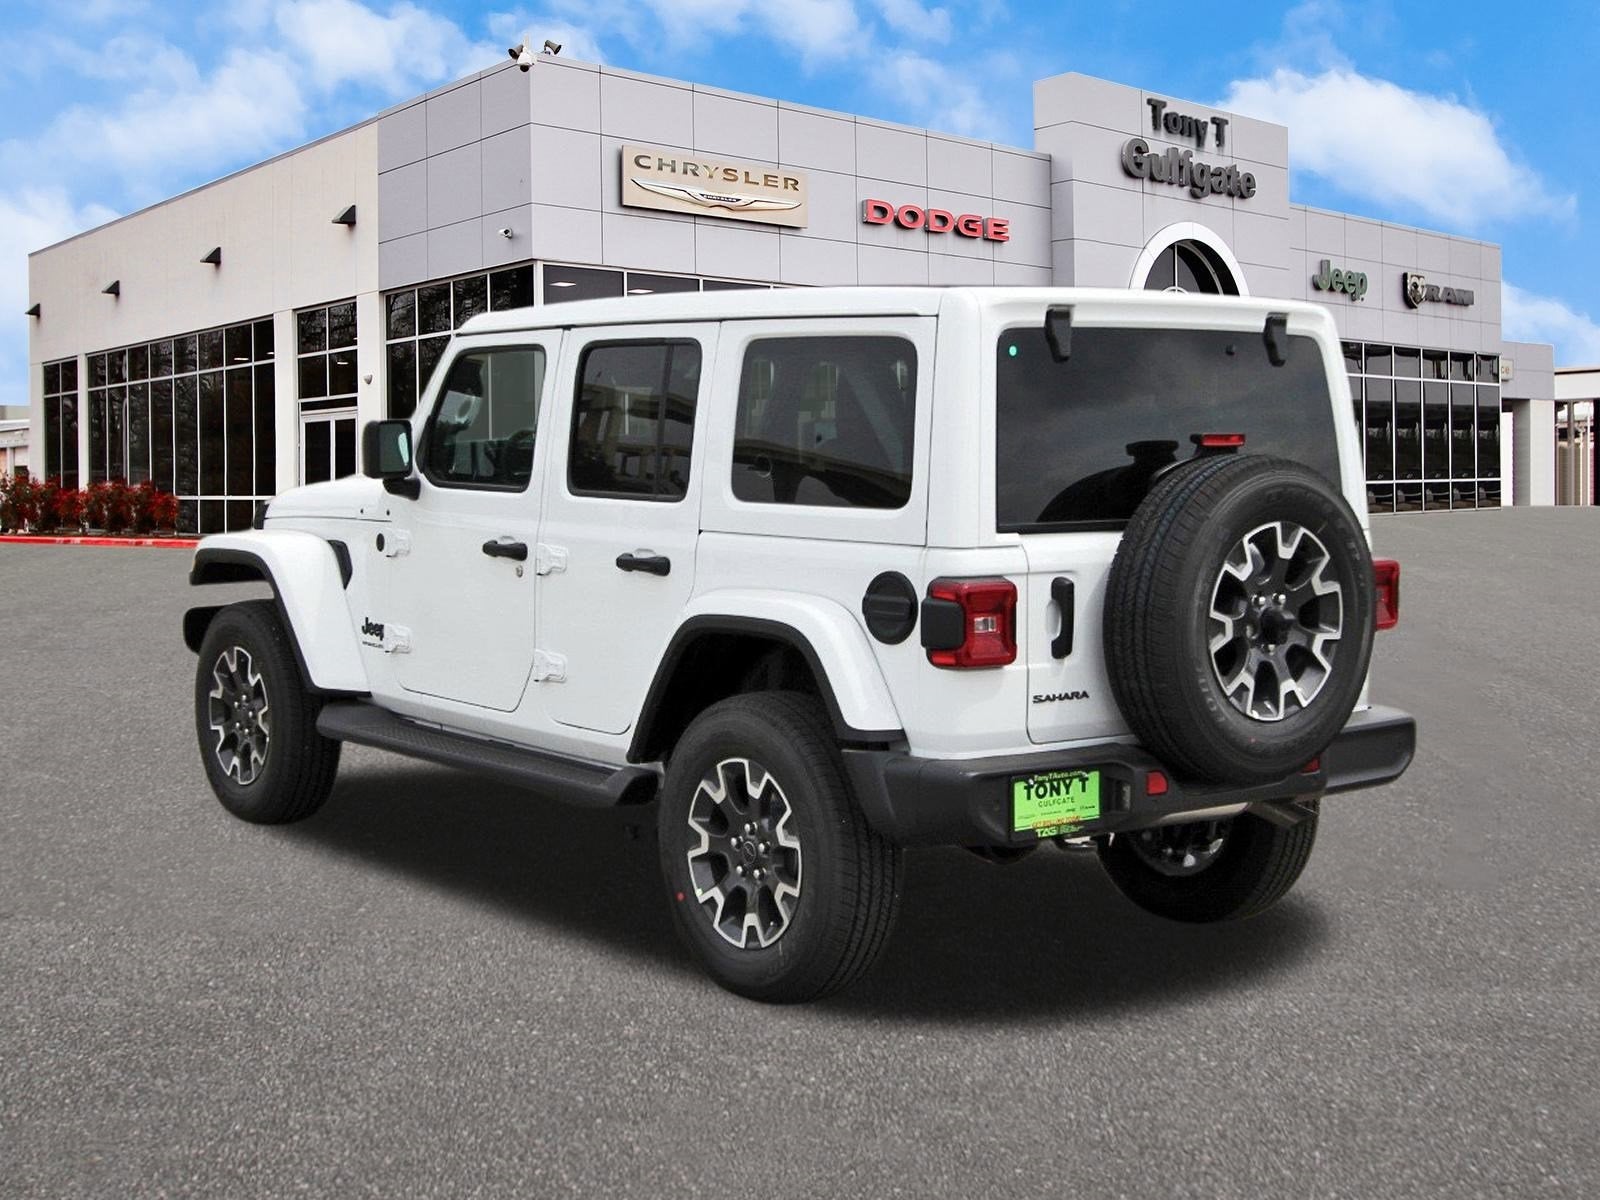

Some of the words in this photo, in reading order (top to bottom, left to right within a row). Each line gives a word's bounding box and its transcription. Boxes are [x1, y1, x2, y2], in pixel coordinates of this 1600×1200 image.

[1146, 98, 1208, 148] Tony
[1210, 116, 1229, 148] T
[634, 154, 800, 191] CHRYSLER
[1121, 138, 1257, 199] Gulfgate
[863, 199, 1010, 242] DODGE
[1312, 259, 1368, 302] Jeep
[1425, 284, 1475, 306] RAM
[1032, 690, 1089, 704] SAHARA
[1023, 779, 1073, 801] TONY
[1078, 777, 1089, 793] T
